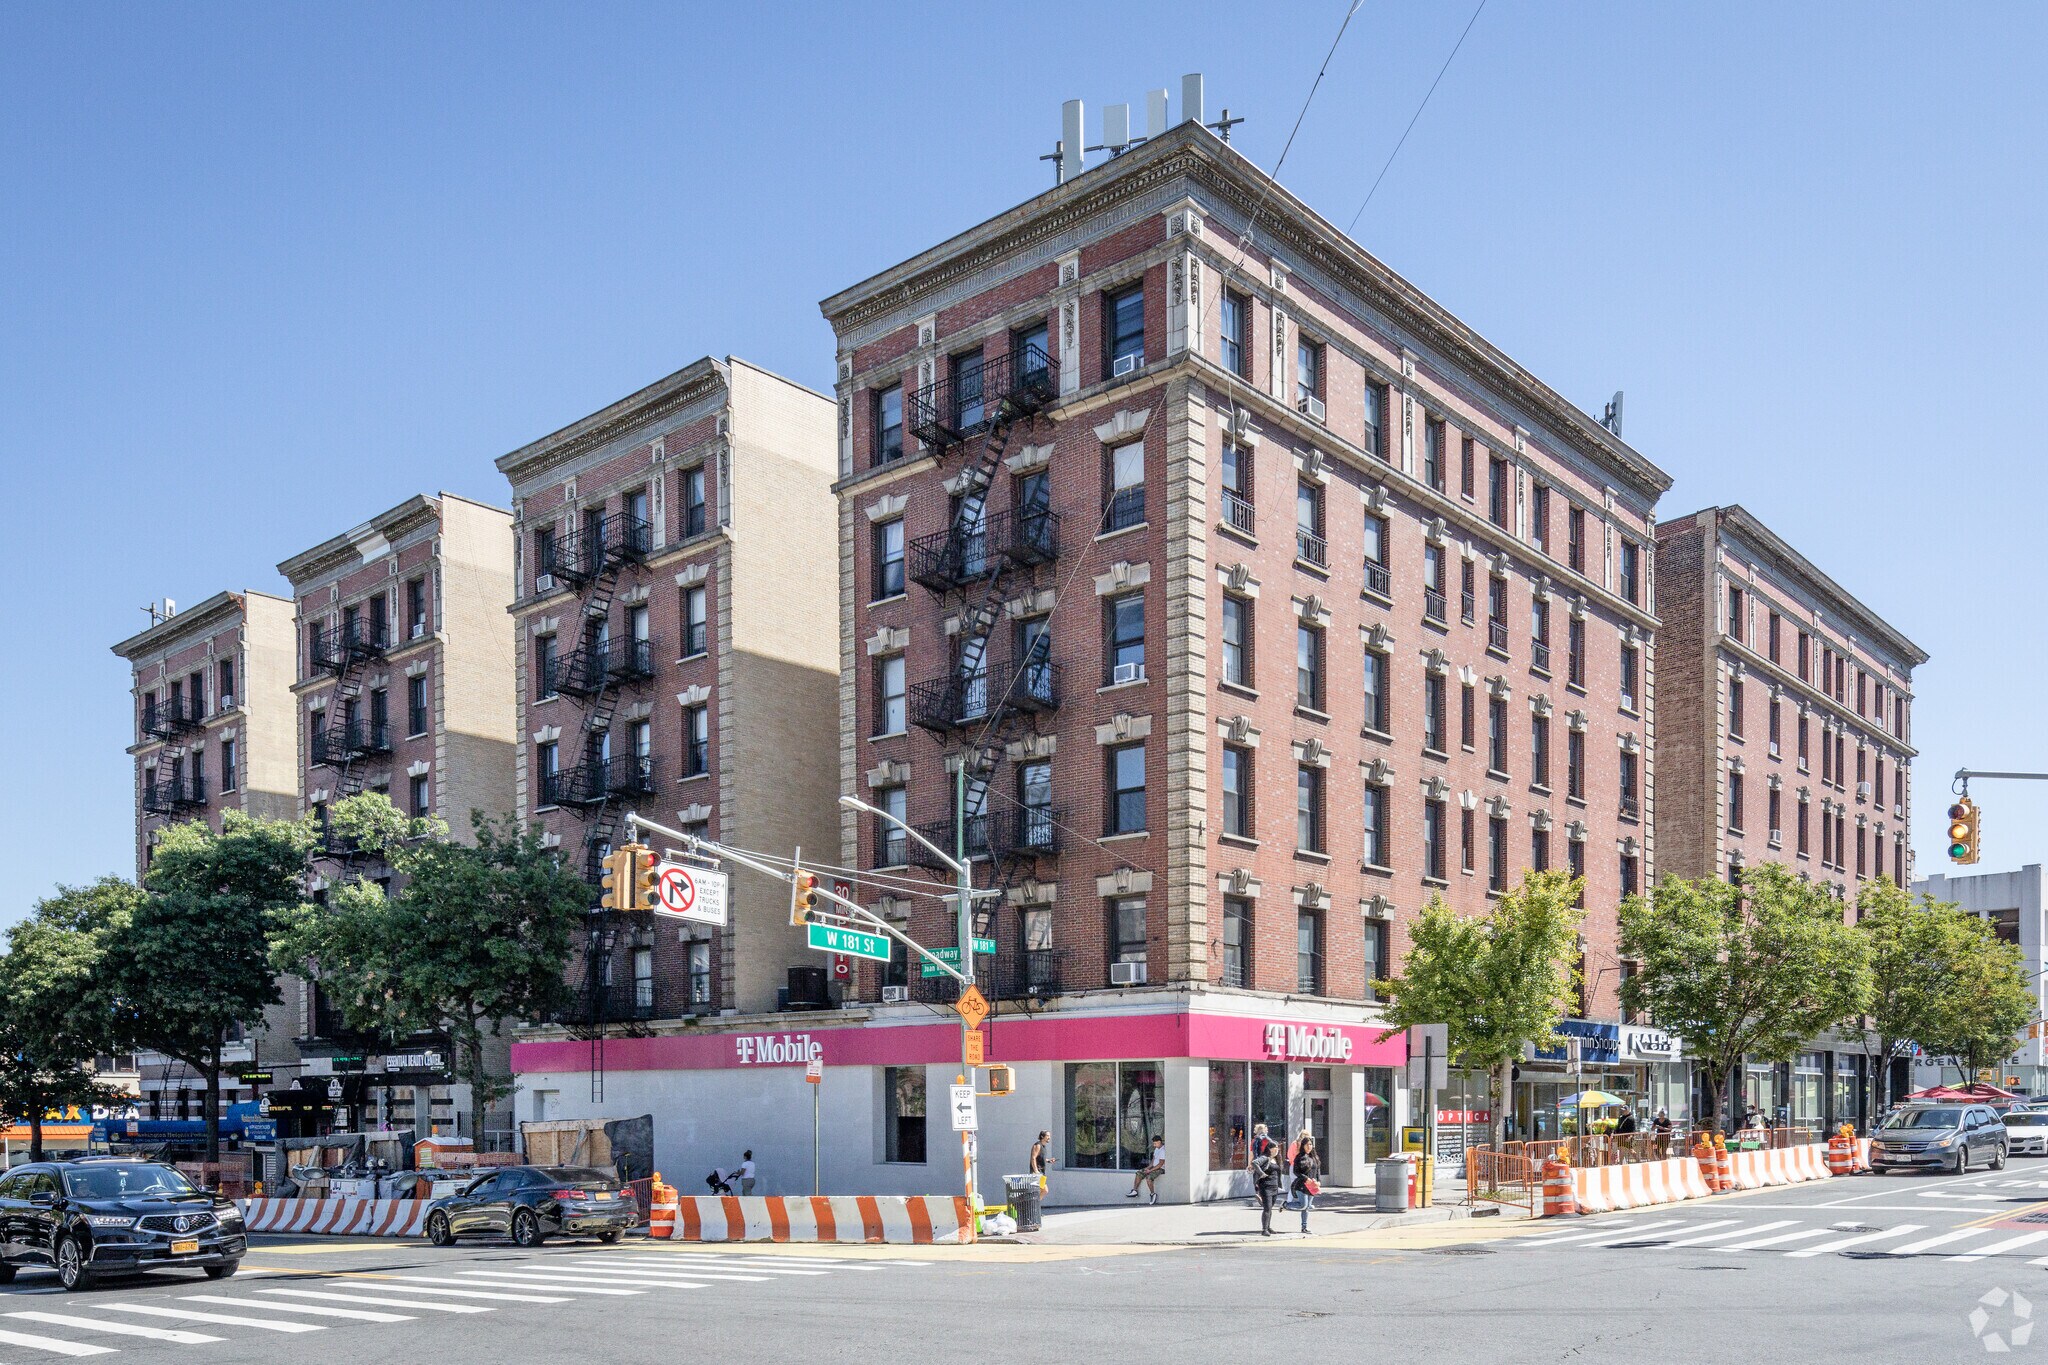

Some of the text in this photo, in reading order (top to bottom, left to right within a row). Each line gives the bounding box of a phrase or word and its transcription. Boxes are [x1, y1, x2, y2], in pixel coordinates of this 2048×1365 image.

[835, 885, 849, 900] 30
[699, 896, 720, 906] TRUCKS
[703, 906, 721, 915] BUSES
[826, 931, 875, 954] W 181 St
[973, 940, 979, 950] W
[980, 941, 989, 951] 181
[954, 1089, 971, 1099] KEEP
[957, 1116, 971, 1125] LEFT
